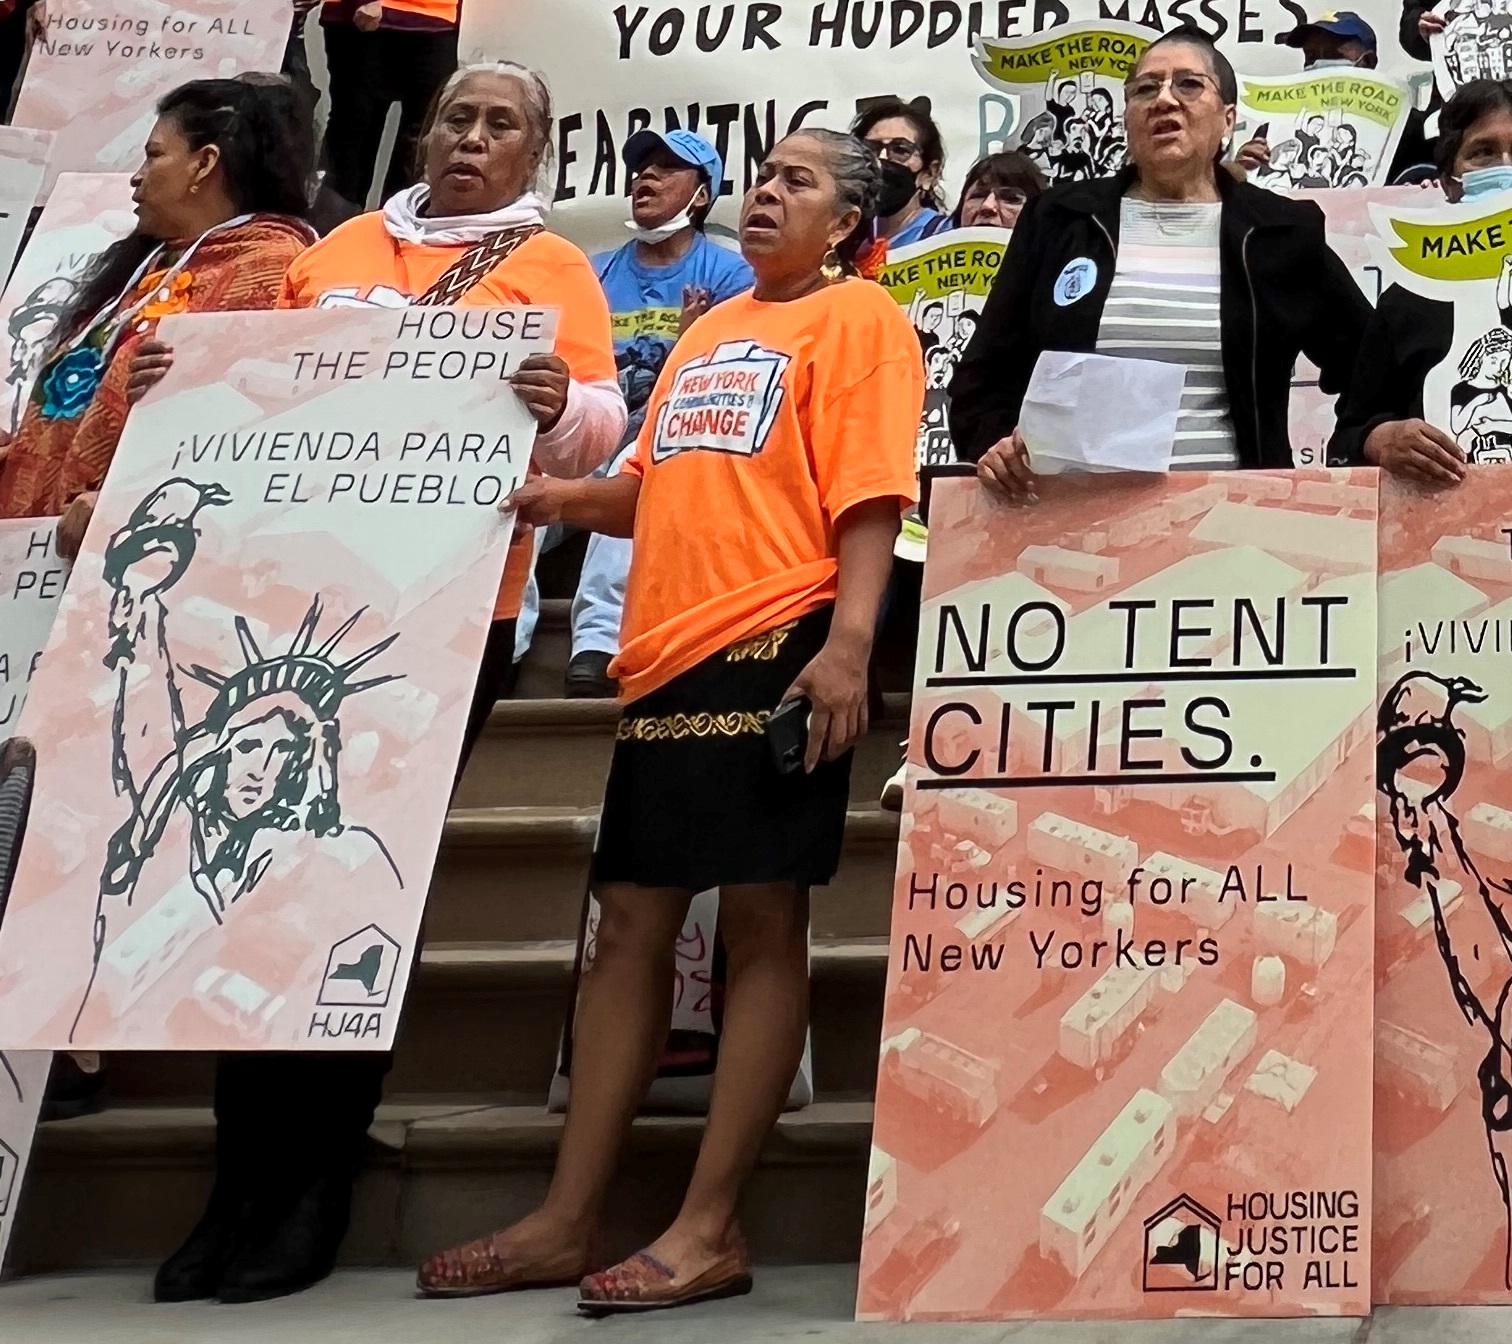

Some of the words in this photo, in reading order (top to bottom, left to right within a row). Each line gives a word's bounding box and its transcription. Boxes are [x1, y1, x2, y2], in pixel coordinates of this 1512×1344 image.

[47, 13, 149, 36] Housing
[160, 15, 197, 34] for
[207, 18, 255, 36] ALL
[613, 2, 783, 60] YOUR
[38, 39, 95, 57] New
[107, 40, 205, 60] Yorkers
[1001, 49, 1052, 70] MAKE
[1054, 36, 1093, 59] THE
[1068, 57, 1105, 71] NEW
[1257, 87, 1306, 104] MAKE
[1309, 82, 1345, 97] THE
[1350, 82, 1399, 108] ROAD
[1320, 95, 1355, 110] NEW
[1357, 99, 1394, 120] YORK
[1421, 224, 1506, 259] MAKE
[880, 264, 921, 288] AKE
[923, 250, 967, 275] THE
[937, 271, 979, 289] NEW
[397, 310, 544, 340] HOUSE
[292, 351, 371, 380] THE
[383, 351, 517, 380] PEOPL
[715, 371, 761, 392] YORK
[667, 409, 751, 439] CHANGE
[171, 431, 380, 470] ¡VIVIENDA
[400, 433, 512, 464] PARA
[264, 473, 312, 503] EL
[935, 601, 1067, 673] NO
[1108, 596, 1349, 669] TENT
[923, 696, 1263, 776] CITIES.
[908, 868, 1103, 913] Housing
[1126, 867, 1196, 905] for
[1218, 864, 1309, 904] ALL
[903, 933, 1005, 972] New
[1029, 929, 1219, 970] Yorkers
[309, 1012, 382, 1039] HJ4A
[1226, 1190, 1360, 1222] HOUSING
[1225, 1224, 1359, 1257] JUSTICE
[1225, 1261, 1284, 1290] FOR
[1304, 1259, 1358, 1289] ALL
